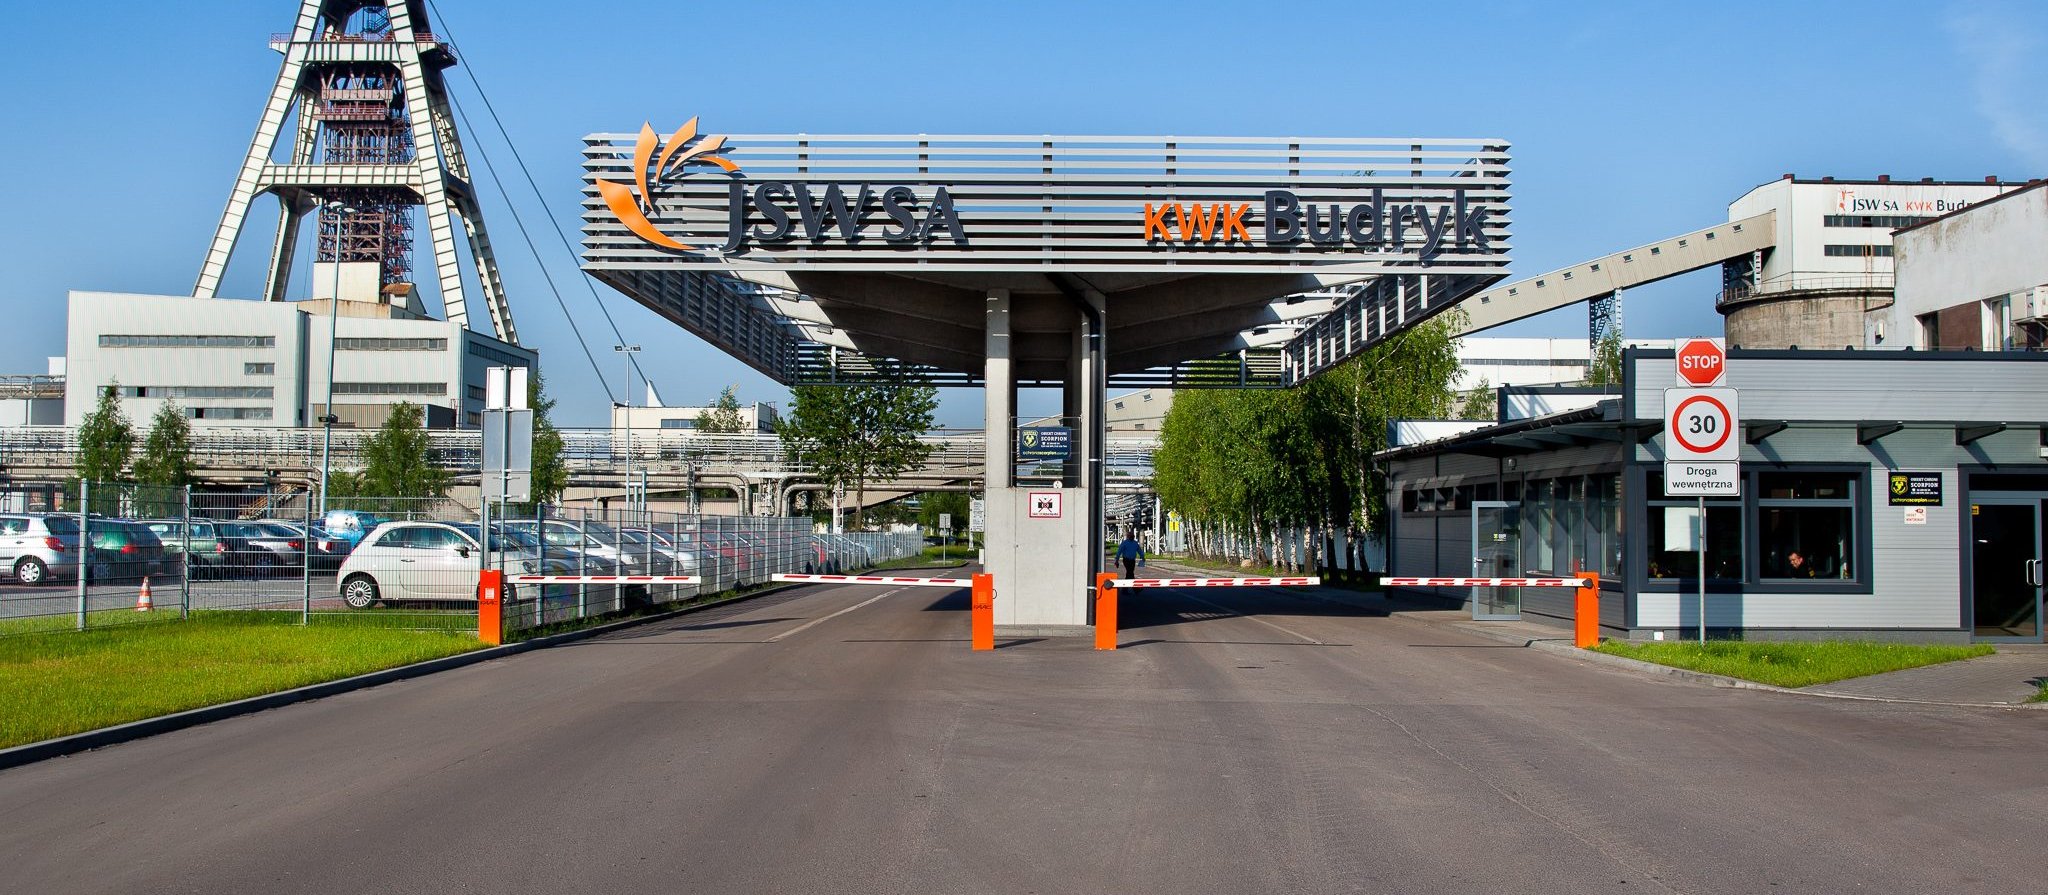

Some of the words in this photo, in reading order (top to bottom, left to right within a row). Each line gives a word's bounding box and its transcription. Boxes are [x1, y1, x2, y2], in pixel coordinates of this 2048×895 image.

[1852, 198, 1881, 212] JSW
[1884, 200, 1899, 211] SA
[1906, 201, 1933, 212] KWK
[1936, 199, 1977, 212] Bud
[720, 181, 871, 254] JSW
[882, 186, 965, 241] SA
[1144, 202, 1252, 243] KWK
[1264, 188, 1490, 261] Budryk
[1682, 355, 1720, 369] STOP
[1689, 415, 1716, 434] 30
[1686, 466, 1718, 477] Droga
[1672, 480, 1733, 491] wewnętrzna
